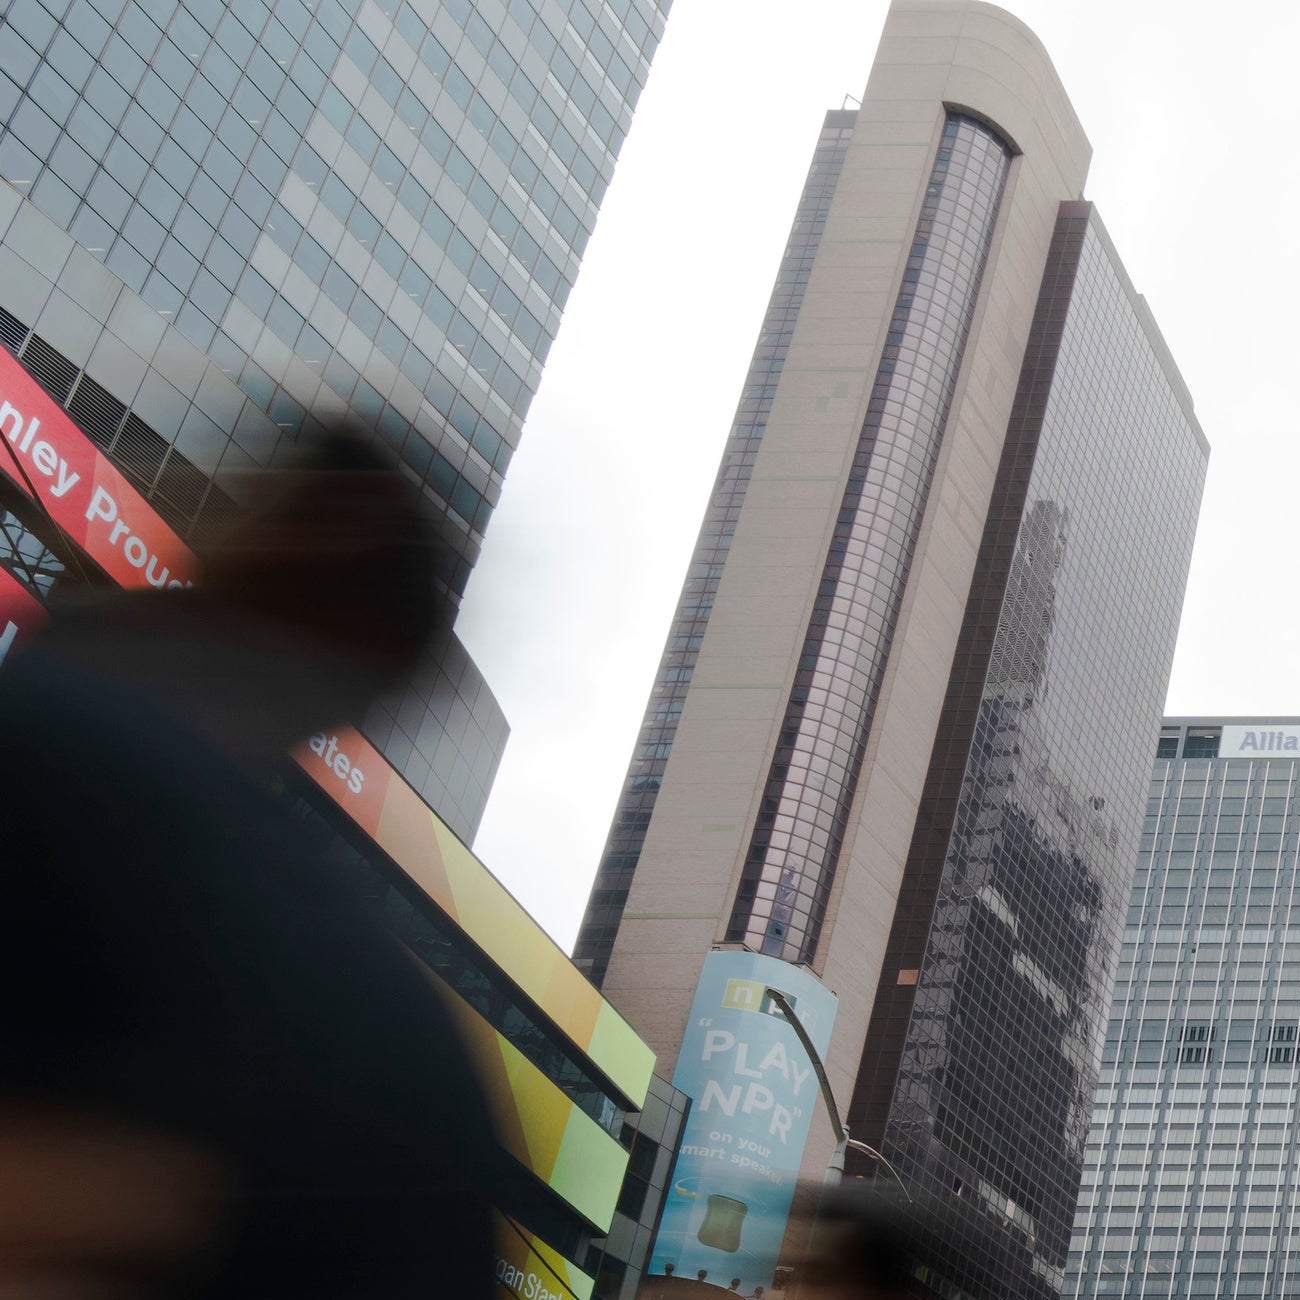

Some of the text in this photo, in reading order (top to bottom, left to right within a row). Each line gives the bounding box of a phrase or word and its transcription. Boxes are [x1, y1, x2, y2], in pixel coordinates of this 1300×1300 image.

[309, 730, 364, 795] ates
[680, 1143, 726, 1161] mart
[709, 1128, 772, 1160] on your
